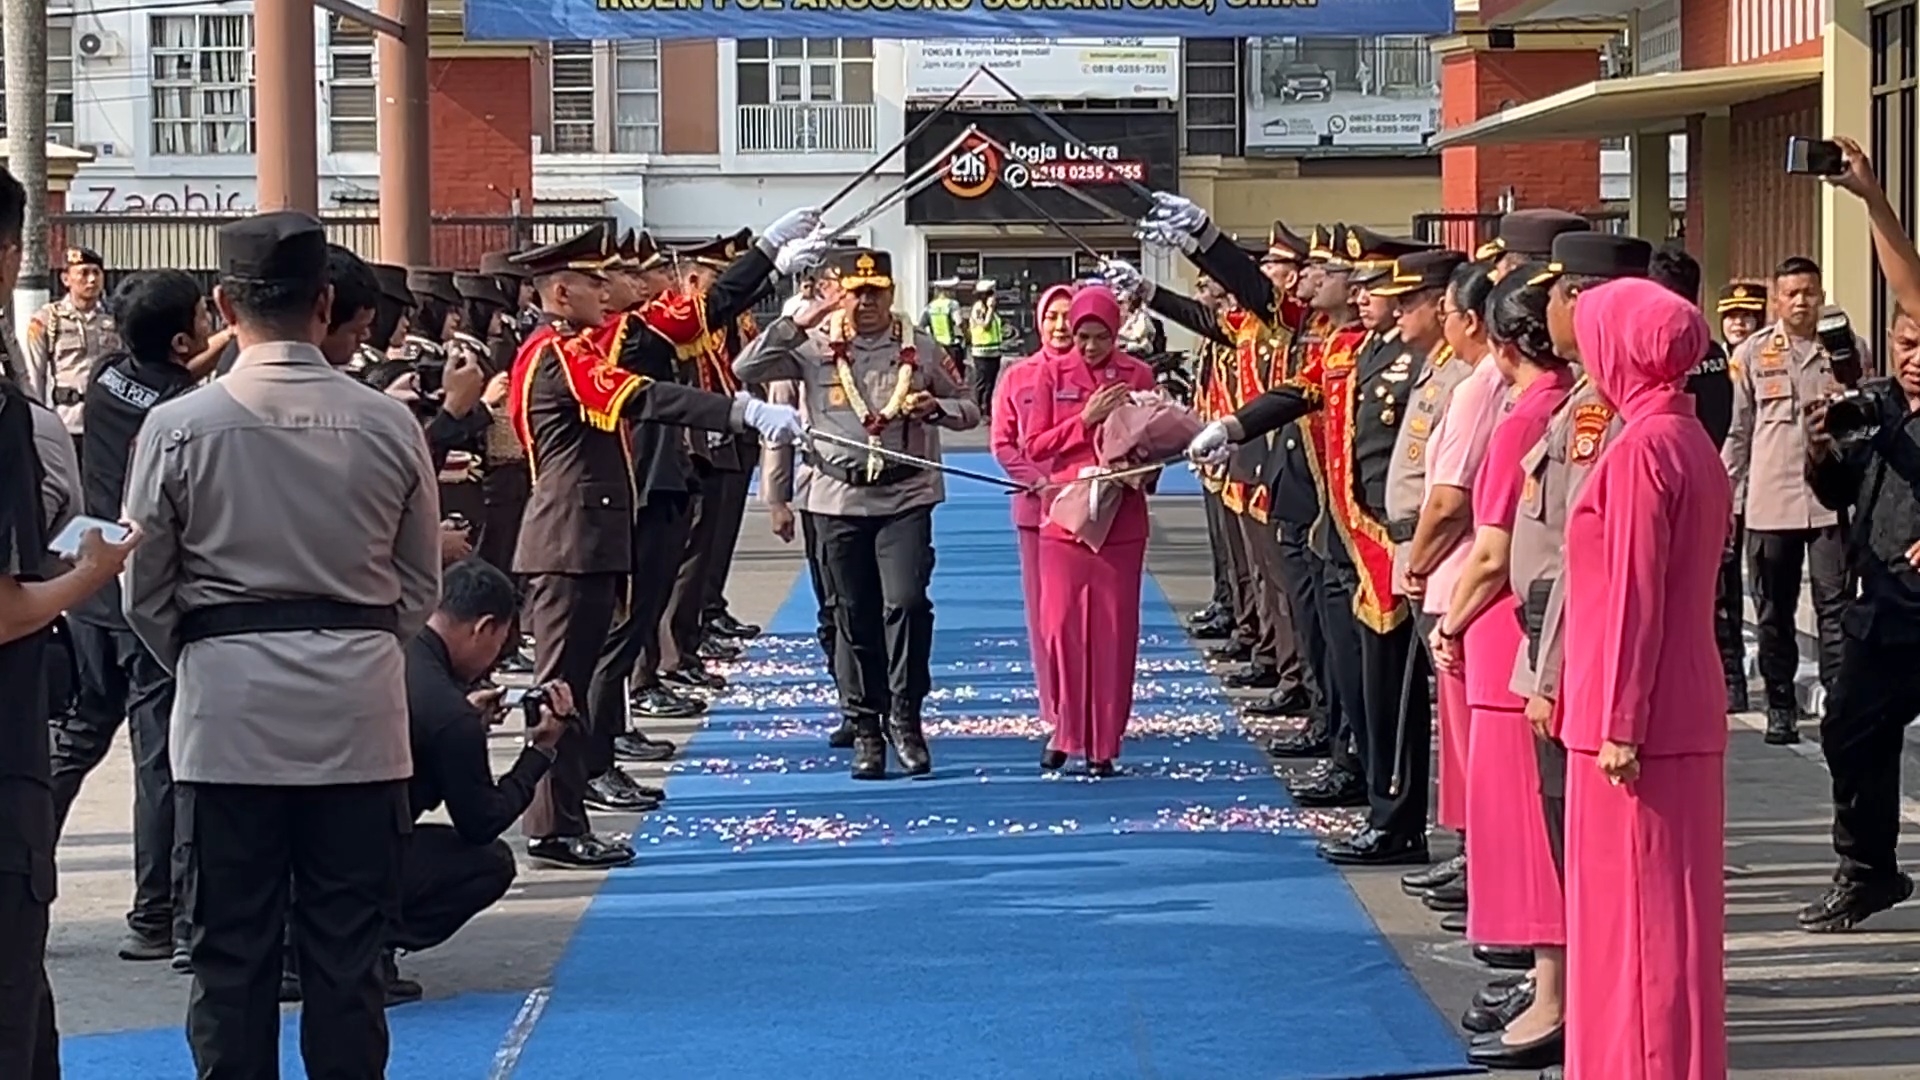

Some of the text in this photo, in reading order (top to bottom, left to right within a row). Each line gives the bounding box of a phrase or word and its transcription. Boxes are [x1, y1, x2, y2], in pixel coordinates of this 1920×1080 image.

[956, 48, 962, 56] &
[1004, 141, 1057, 164] Jogja
[1069, 165, 1104, 180] 0255
